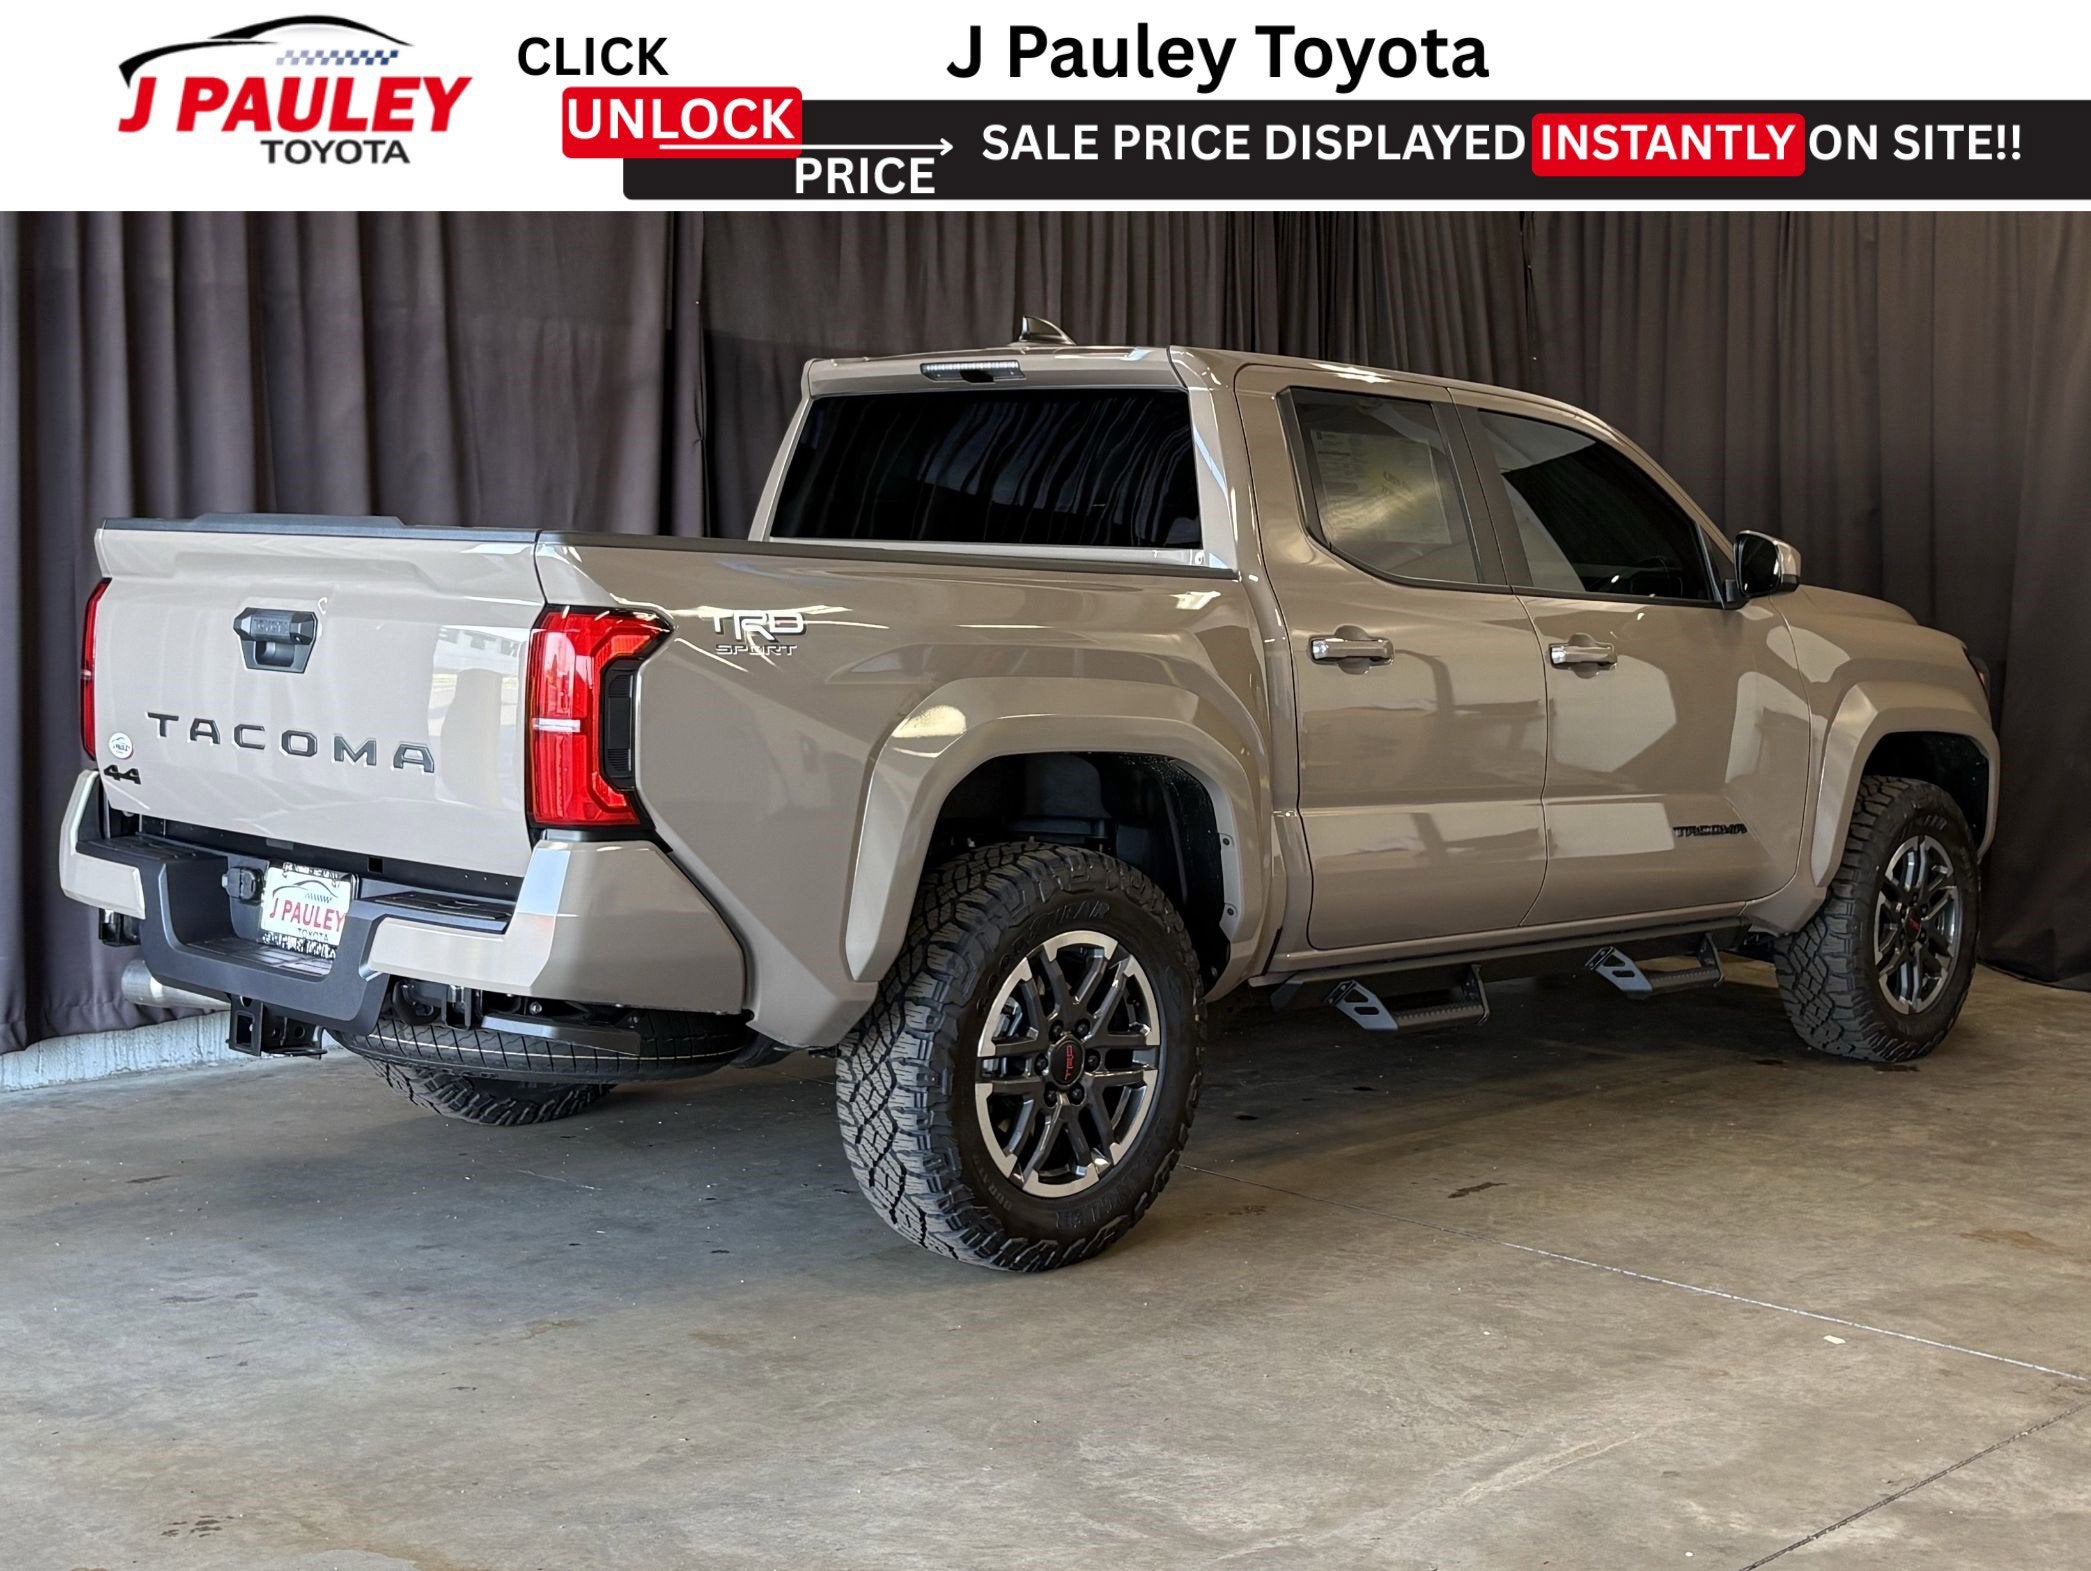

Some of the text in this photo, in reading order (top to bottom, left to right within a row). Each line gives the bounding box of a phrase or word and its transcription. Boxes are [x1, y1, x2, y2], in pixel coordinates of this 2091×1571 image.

[715, 643, 798, 656] SPORT
[146, 711, 437, 775] TACOMA
[269, 897, 346, 932] J PAULEY
[297, 927, 329, 941] TOYOTA
